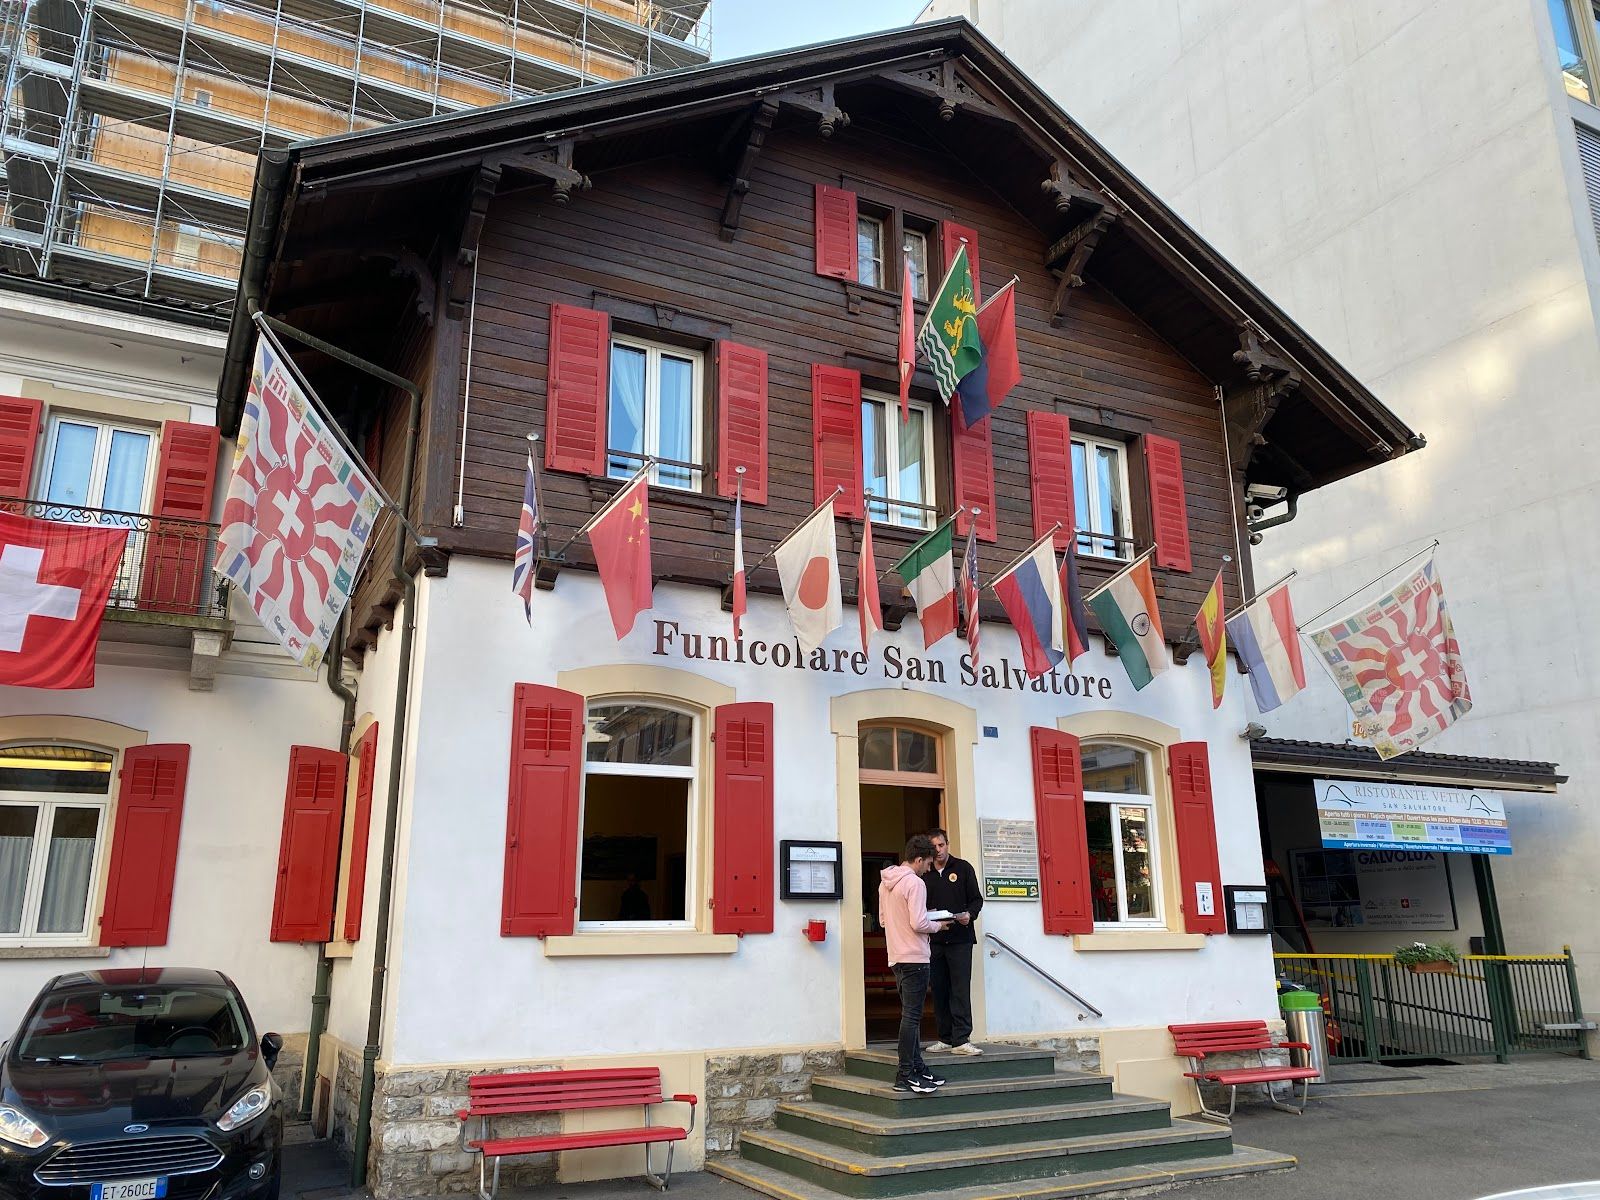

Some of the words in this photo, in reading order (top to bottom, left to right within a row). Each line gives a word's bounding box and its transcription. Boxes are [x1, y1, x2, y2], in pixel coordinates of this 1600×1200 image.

[652, 620, 869, 676] Funicolare
[883, 645, 947, 684] San
[959, 653, 1113, 700] Salvatore
[1354, 786, 1429, 801] RISTORANTE
[1433, 791, 1468, 804] VETTA
[1404, 803, 1446, 812] SALVATORE
[1358, 851, 1435, 865] GALVOLUX
[102, 1187, 117, 1199] ET
[120, 1183, 155, 1198] 260CE
